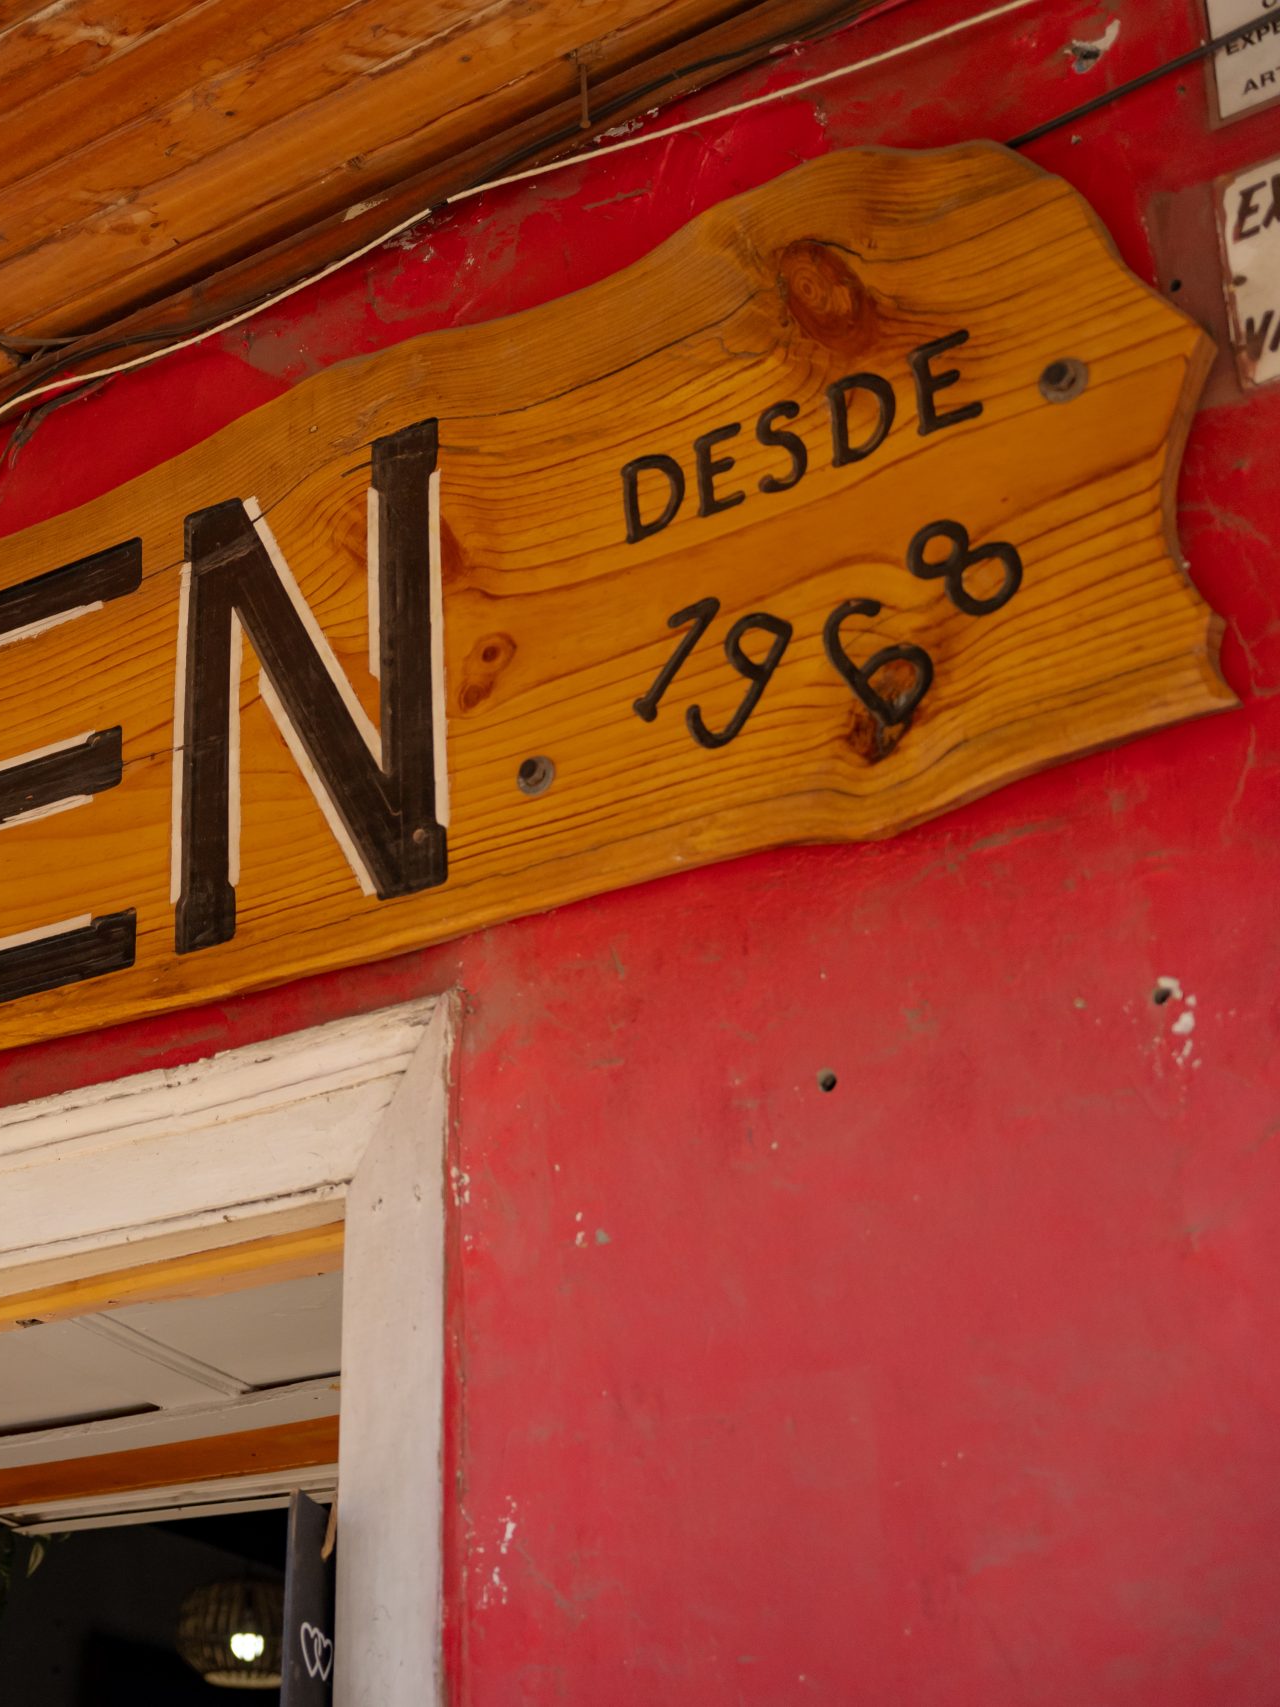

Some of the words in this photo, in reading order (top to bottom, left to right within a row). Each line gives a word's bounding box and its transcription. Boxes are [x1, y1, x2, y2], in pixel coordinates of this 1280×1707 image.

[1243, 66, 1280, 95] AR
[620, 328, 984, 545] DESDE
[632, 519, 1023, 751] 1968
